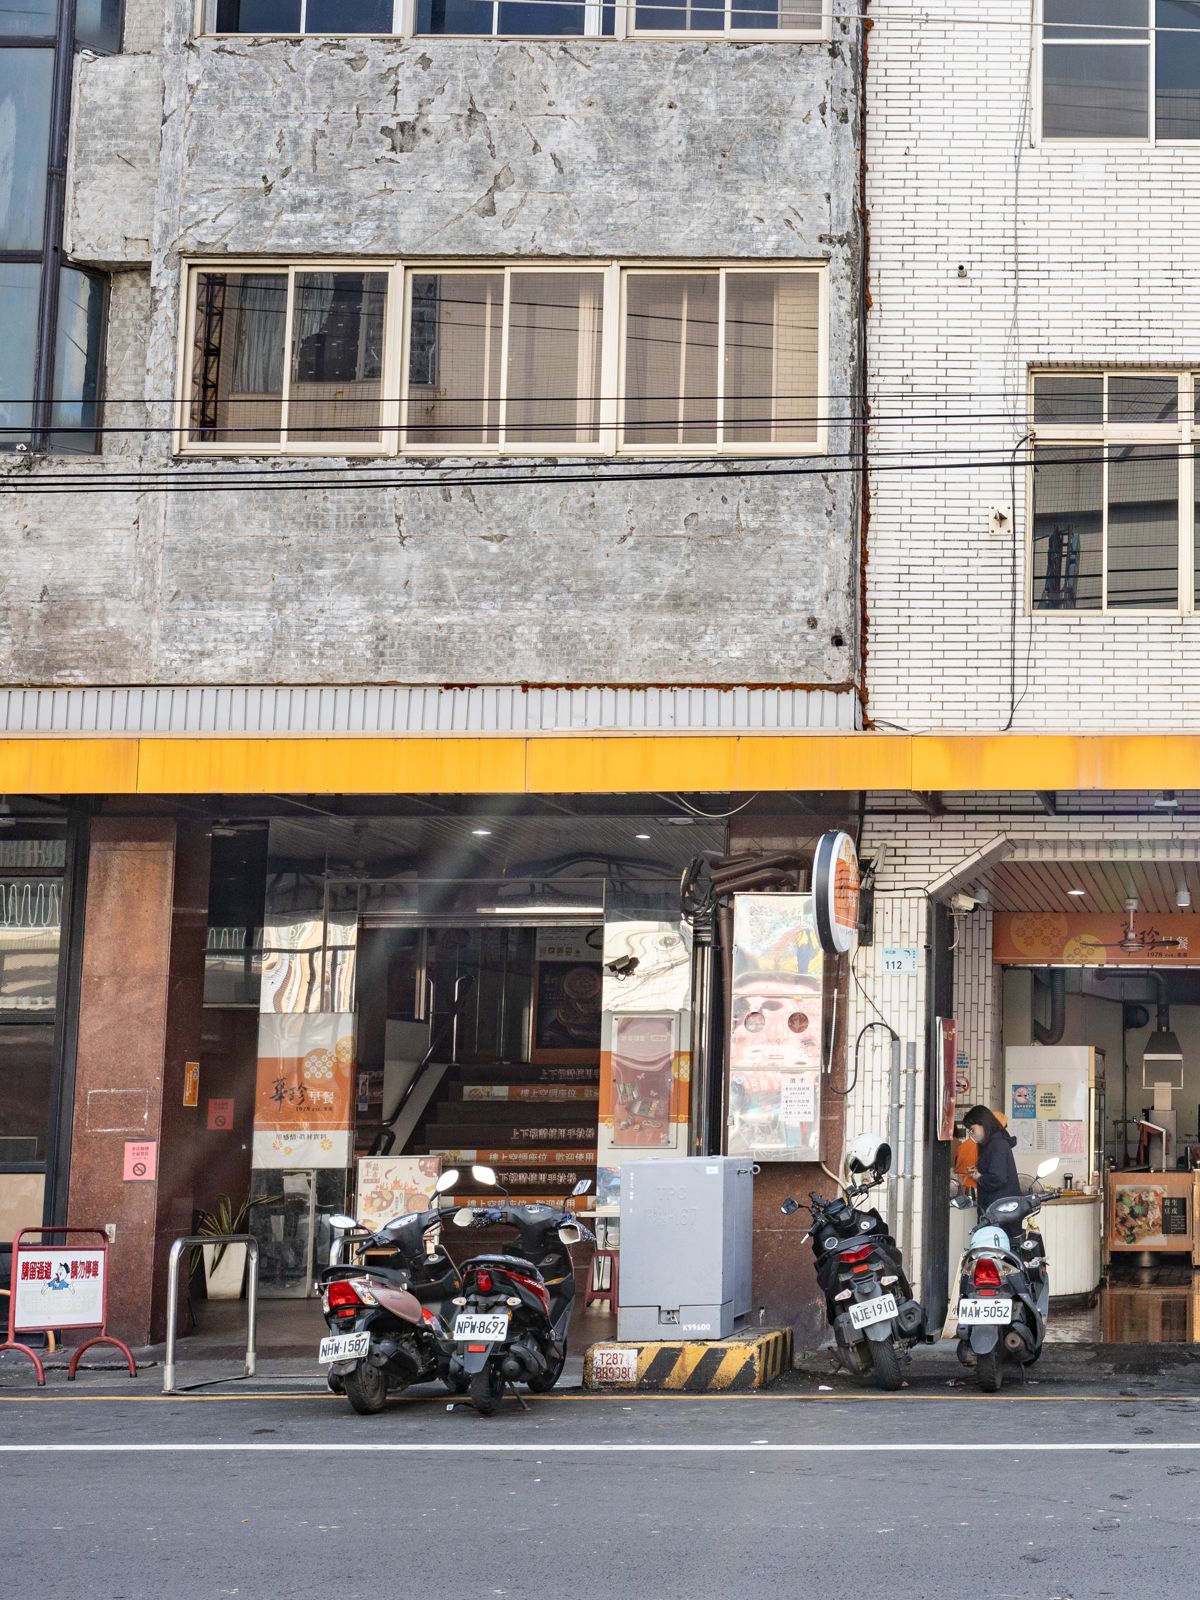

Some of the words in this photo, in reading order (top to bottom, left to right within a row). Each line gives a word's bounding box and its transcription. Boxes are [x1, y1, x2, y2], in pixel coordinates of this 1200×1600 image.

[885, 960, 903, 970] 112
[21, 1261, 52, 1280] 請留通道
[70, 1260, 99, 1279] 請勿停車
[852, 1300, 896, 1325] NJE-1910
[960, 1306, 1010, 1319] MAW-5052
[456, 1321, 506, 1335] NPW-8692
[320, 1338, 367, 1358] NHW-1587
